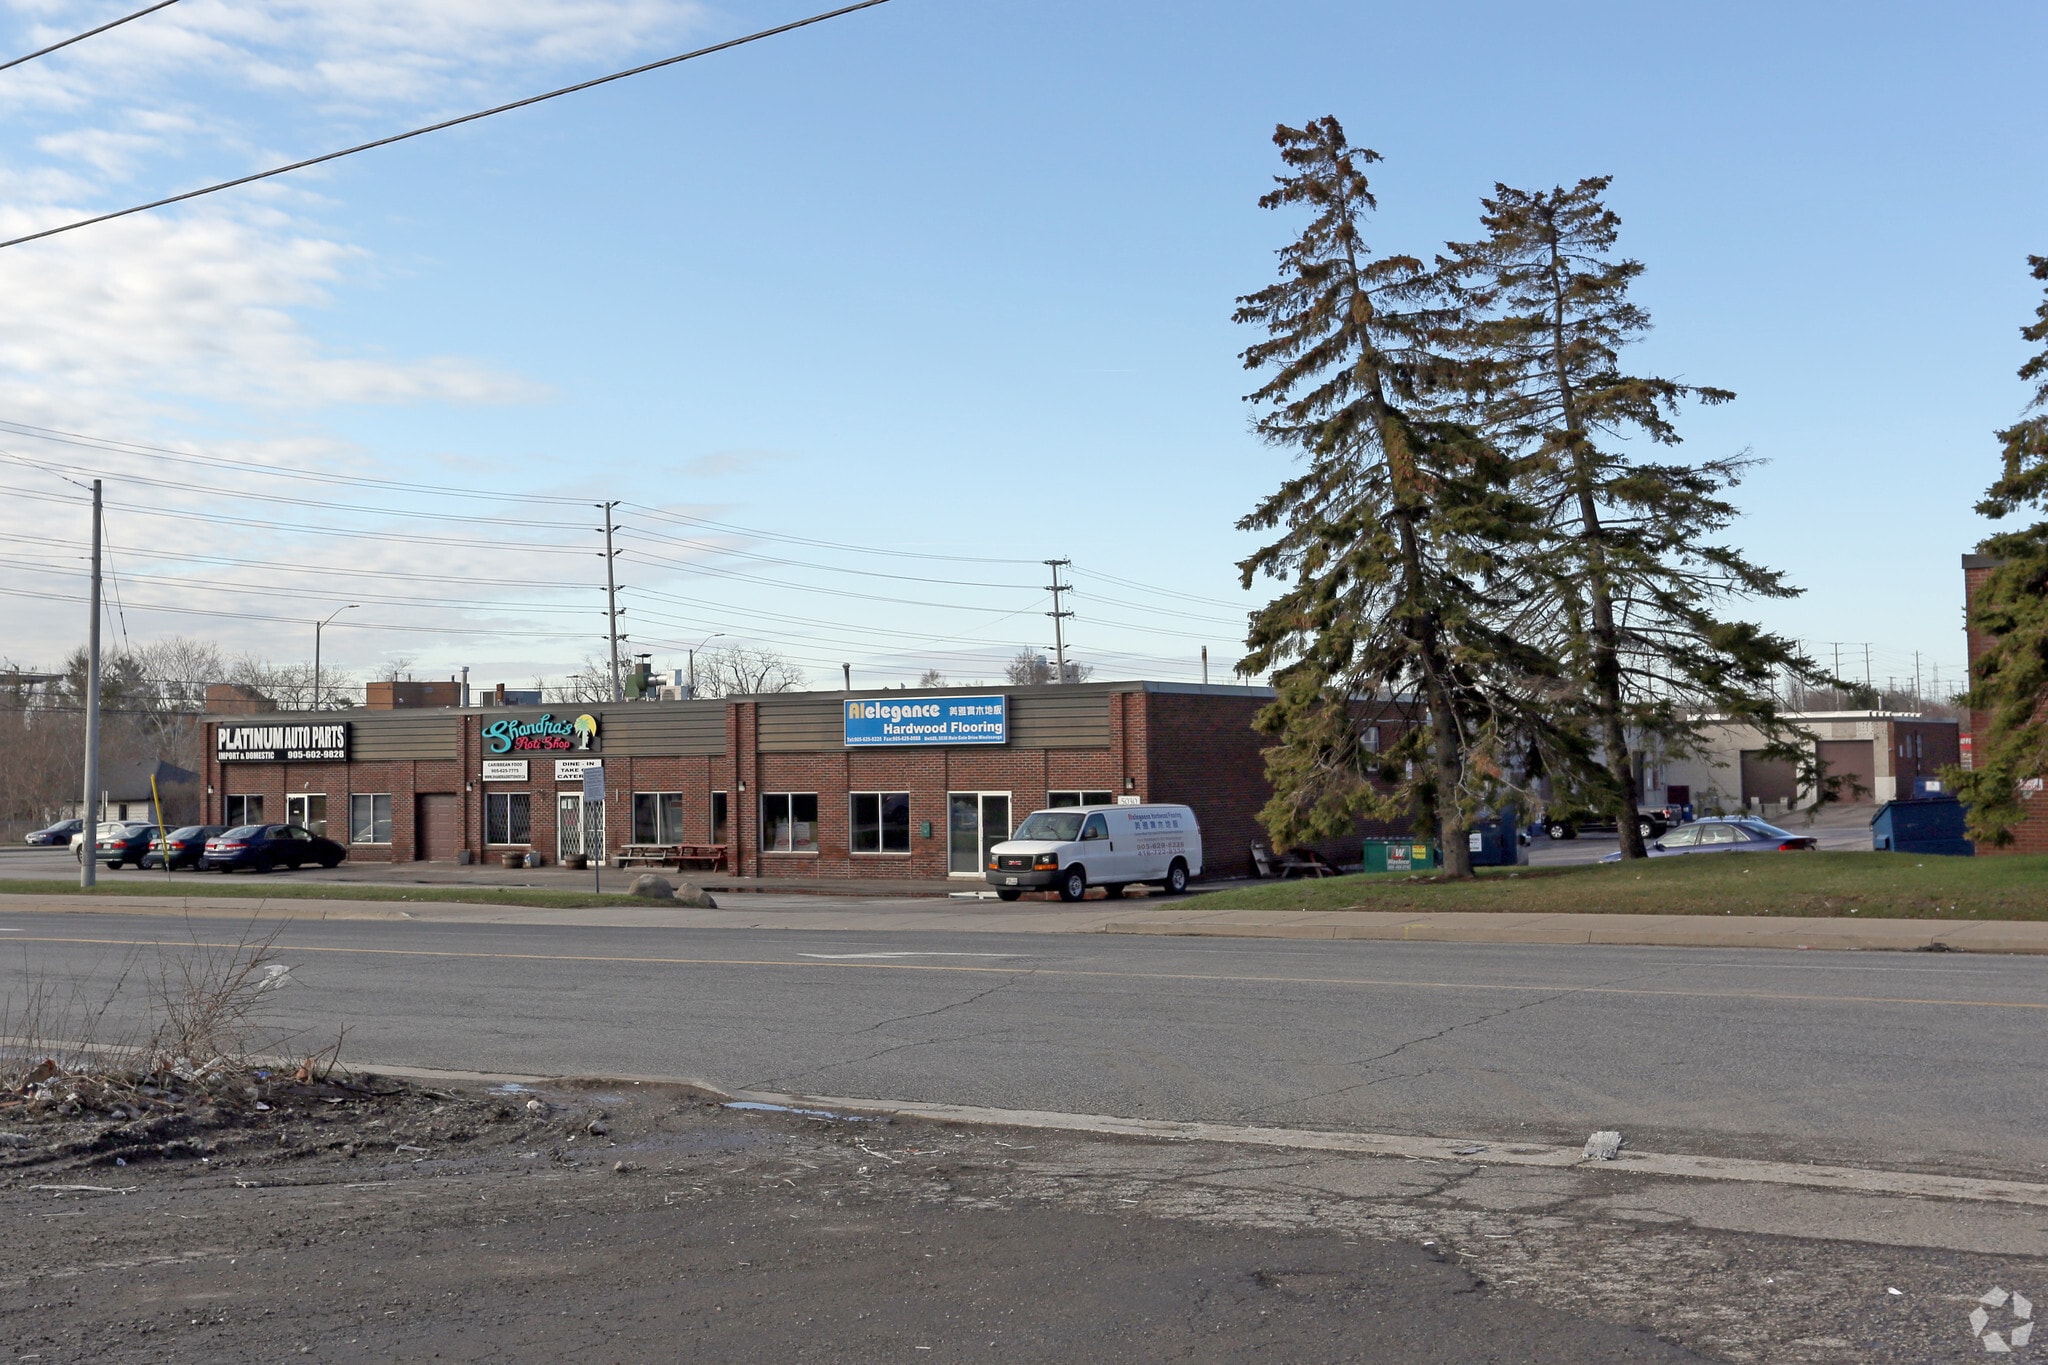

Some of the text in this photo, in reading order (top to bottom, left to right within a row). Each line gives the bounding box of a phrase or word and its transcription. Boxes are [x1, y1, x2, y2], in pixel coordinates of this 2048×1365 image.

[482, 713, 573, 753] Shandra's
[883, 721, 1003, 734] Hardwood Flooring
[218, 725, 344, 750] PLATINUM AUTO PARTS
[514, 736, 571, 750] Roti Shop
[218, 752, 240, 760] IMPORT
[245, 751, 275, 760] DOMESTIC
[288, 751, 344, 759] 905-602-9828
